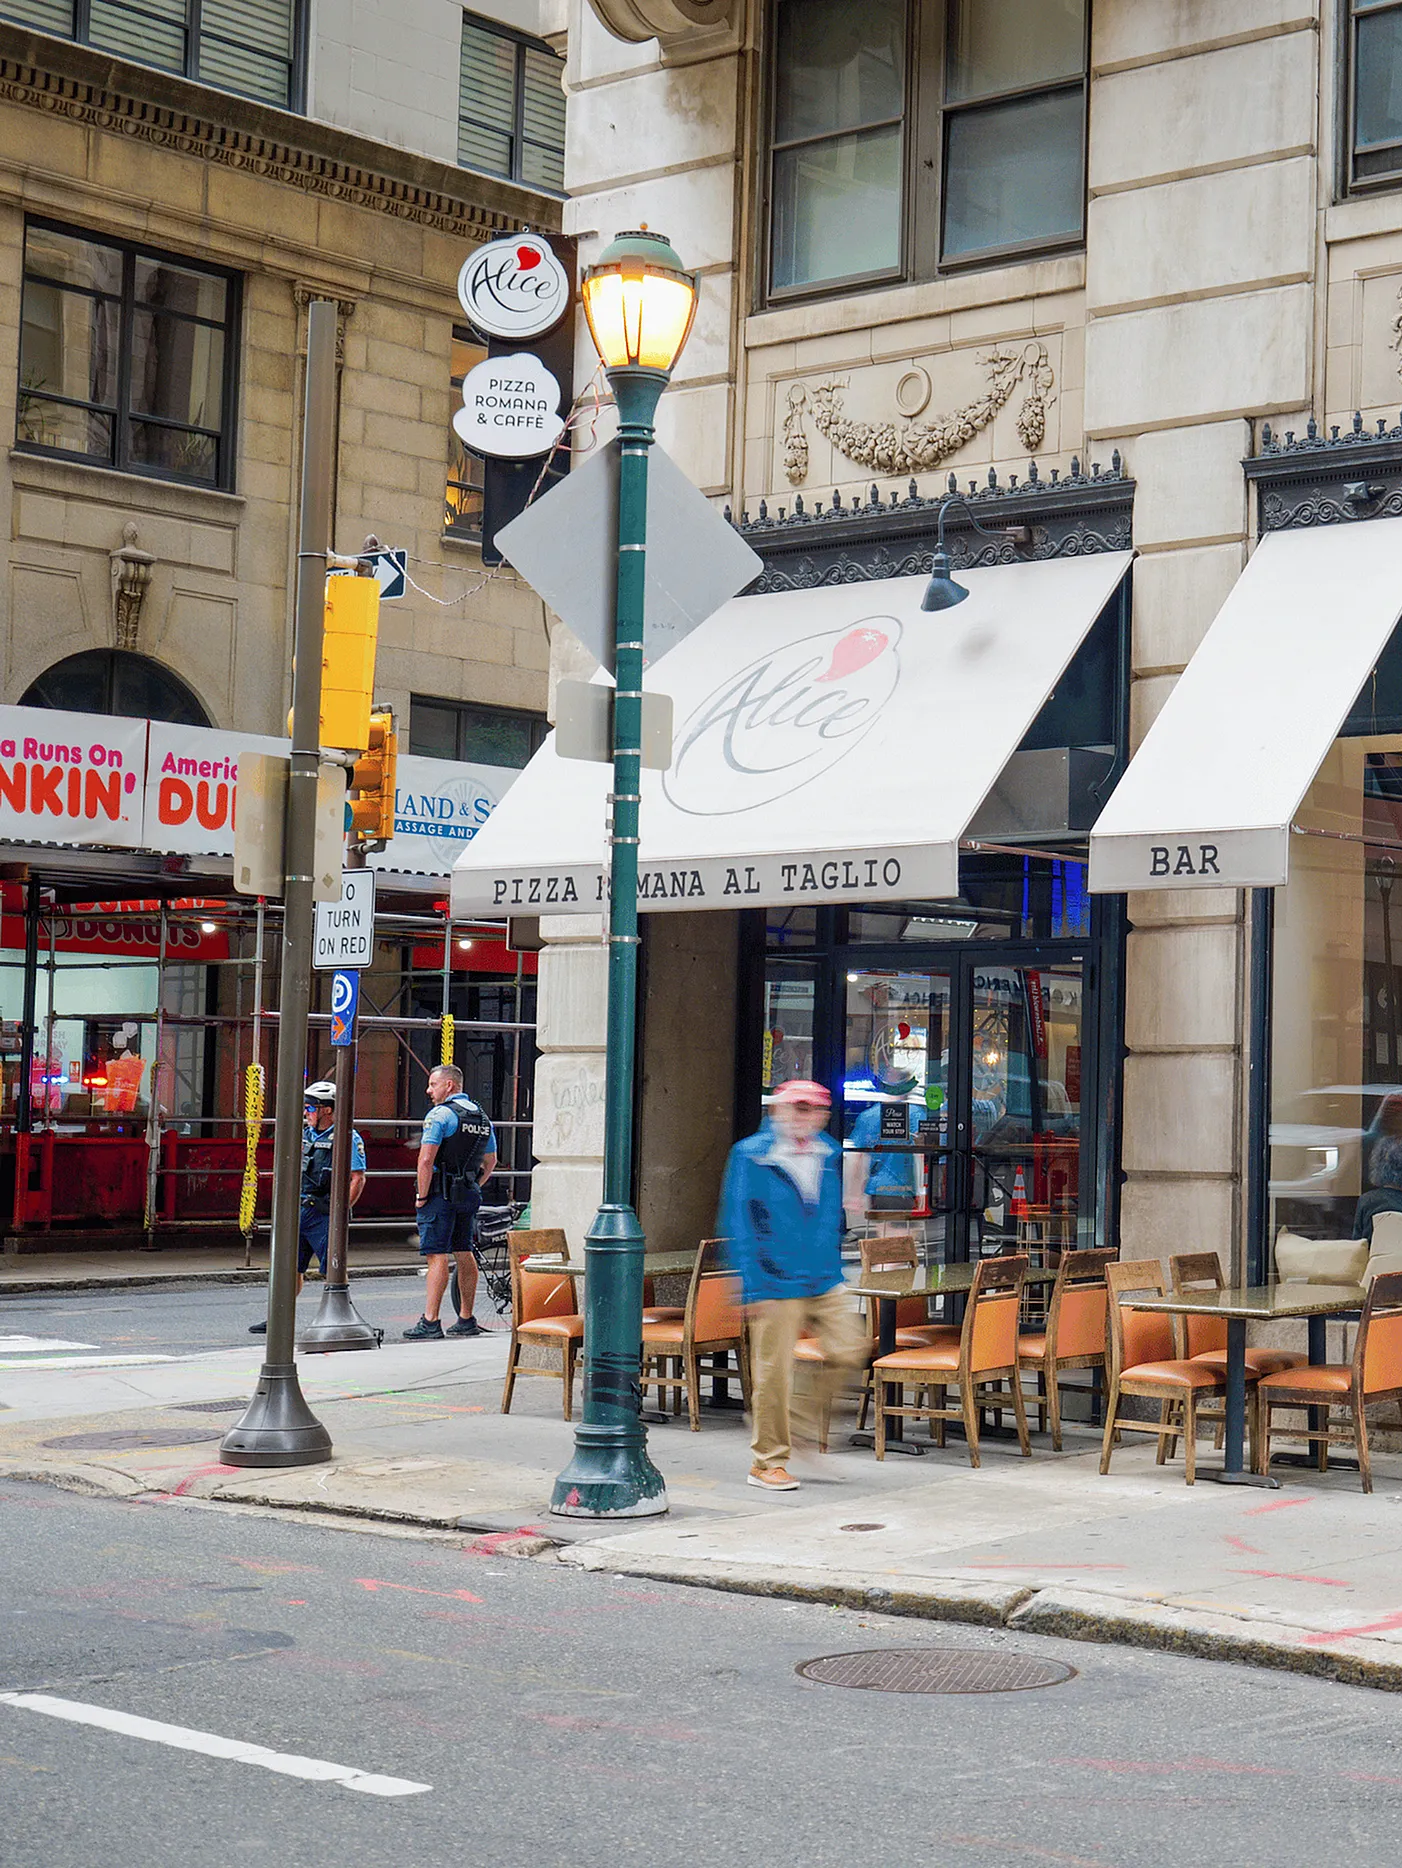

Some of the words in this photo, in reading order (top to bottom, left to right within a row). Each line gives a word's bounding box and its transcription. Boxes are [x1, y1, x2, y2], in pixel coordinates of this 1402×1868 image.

[472, 258, 553, 313] Alice
[489, 379, 535, 393] PIZZA
[475, 396, 547, 411] ROMANA
[477, 413, 487, 425] &
[494, 414, 544, 429] CAFFÈ
[675, 656, 870, 774] Alice
[23, 737, 82, 764] Runs
[89, 744, 122, 768] On
[161, 752, 237, 781] Americ
[158, 777, 237, 832] DU
[459, 802, 469, 816] &
[474, 798, 497, 824] S
[396, 821, 443, 835] ASSAGE
[449, 829, 473, 838] AND
[1149, 845, 1220, 876] BAR
[493, 876, 578, 904] PIZZA
[596, 870, 705, 900] RMANA
[723, 867, 760, 895] AL
[782, 857, 901, 891] TAGLIO
[327, 910, 360, 928] TURN
[319, 938, 334, 955] ON
[341, 936, 366, 954] RED
[462, 1123, 490, 1136] POLICE
